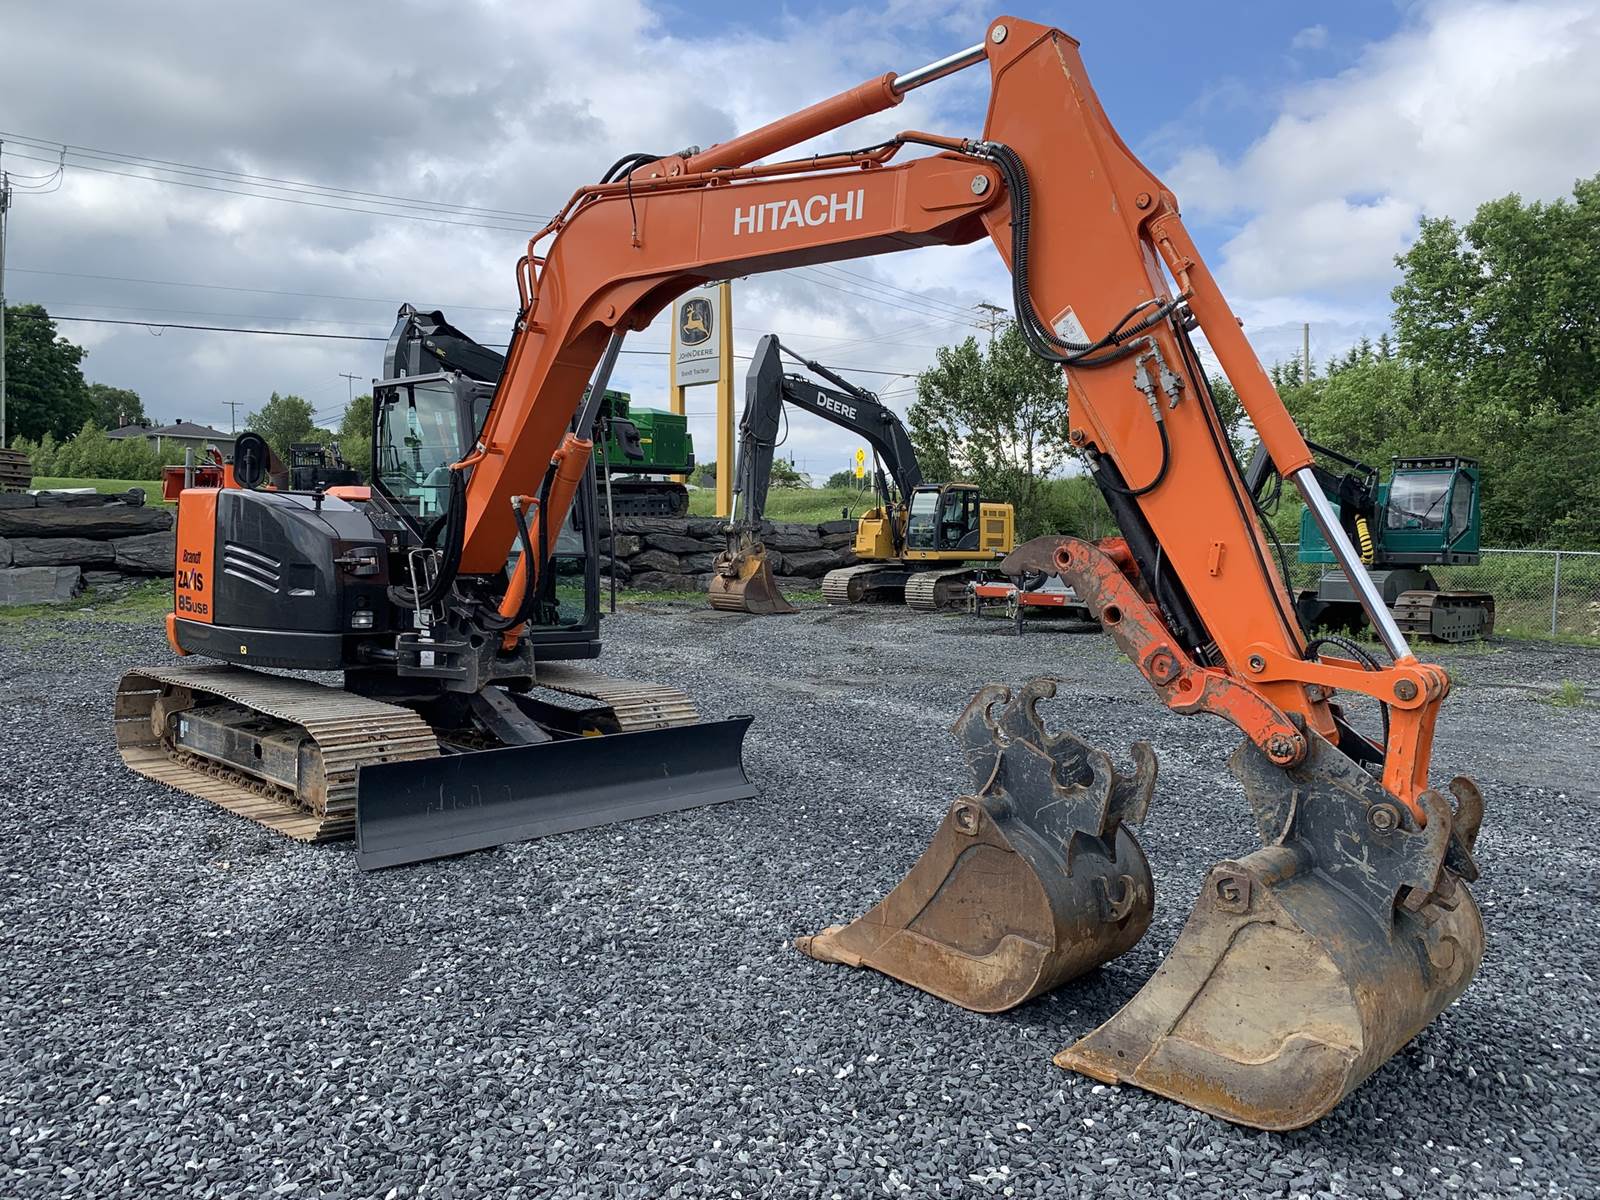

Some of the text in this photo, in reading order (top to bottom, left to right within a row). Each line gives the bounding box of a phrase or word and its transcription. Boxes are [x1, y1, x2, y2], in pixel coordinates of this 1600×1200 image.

[733, 189, 865, 236] HITACHI
[692, 348, 713, 357] DEERE
[816, 391, 857, 420] DEERE
[182, 549, 202, 564] Brandt
